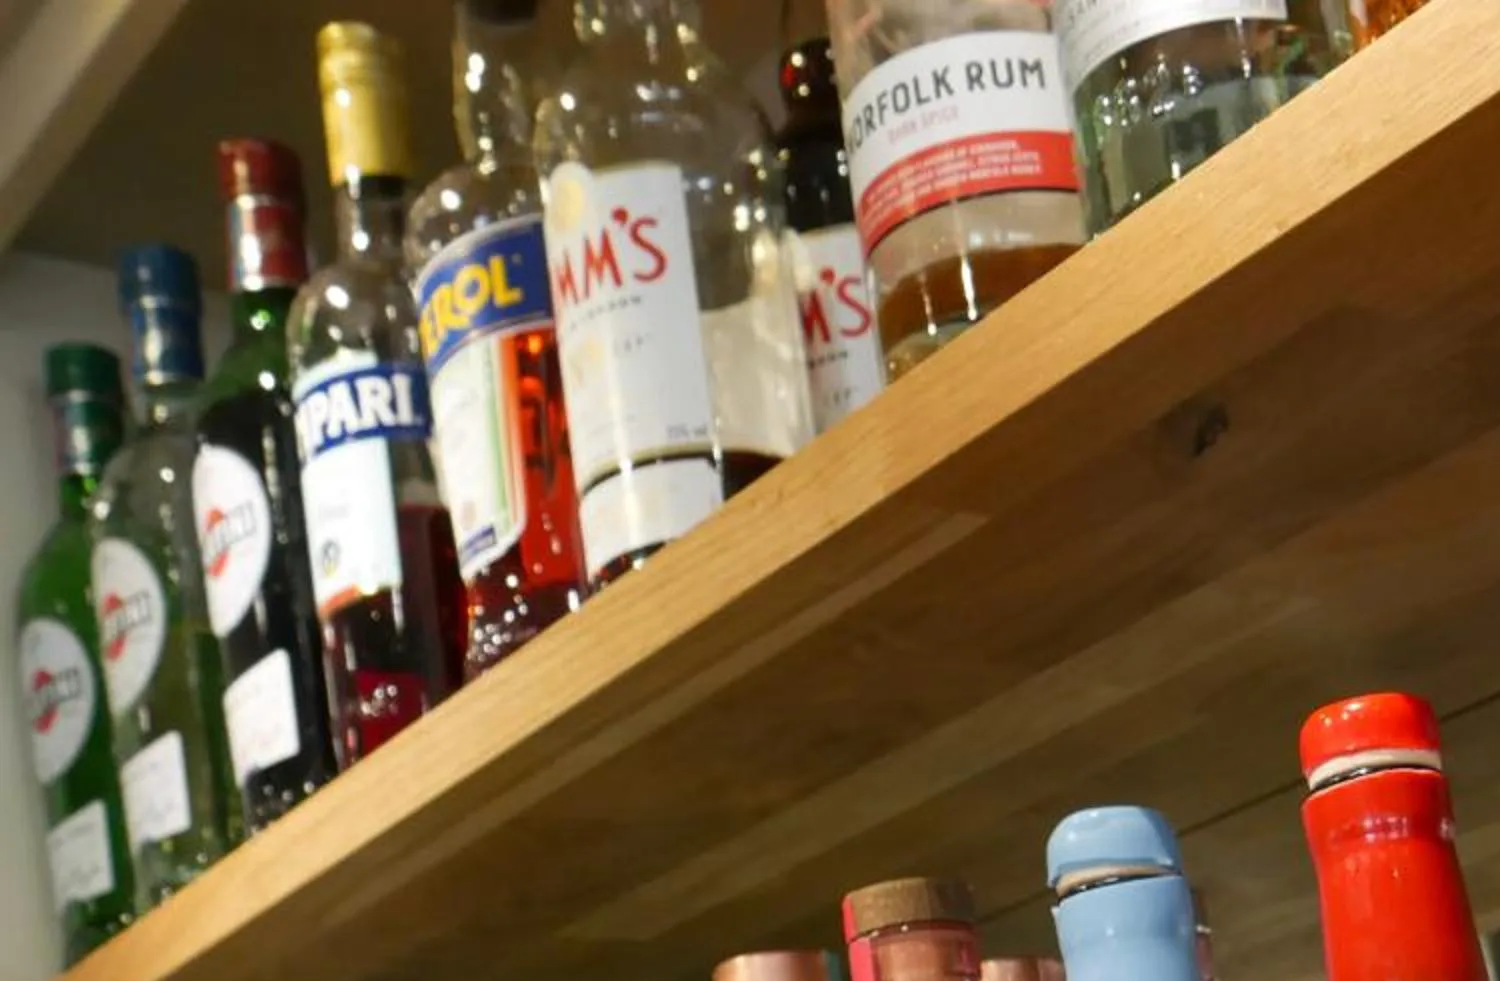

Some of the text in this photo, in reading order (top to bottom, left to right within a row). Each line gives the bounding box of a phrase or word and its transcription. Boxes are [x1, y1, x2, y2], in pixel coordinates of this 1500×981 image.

[849, 57, 1046, 148] ORFOLK RUM
[556, 207, 667, 304] MM'S
[418, 254, 524, 356] EROL
[801, 267, 874, 344] M'S
[298, 372, 415, 452] PARI
